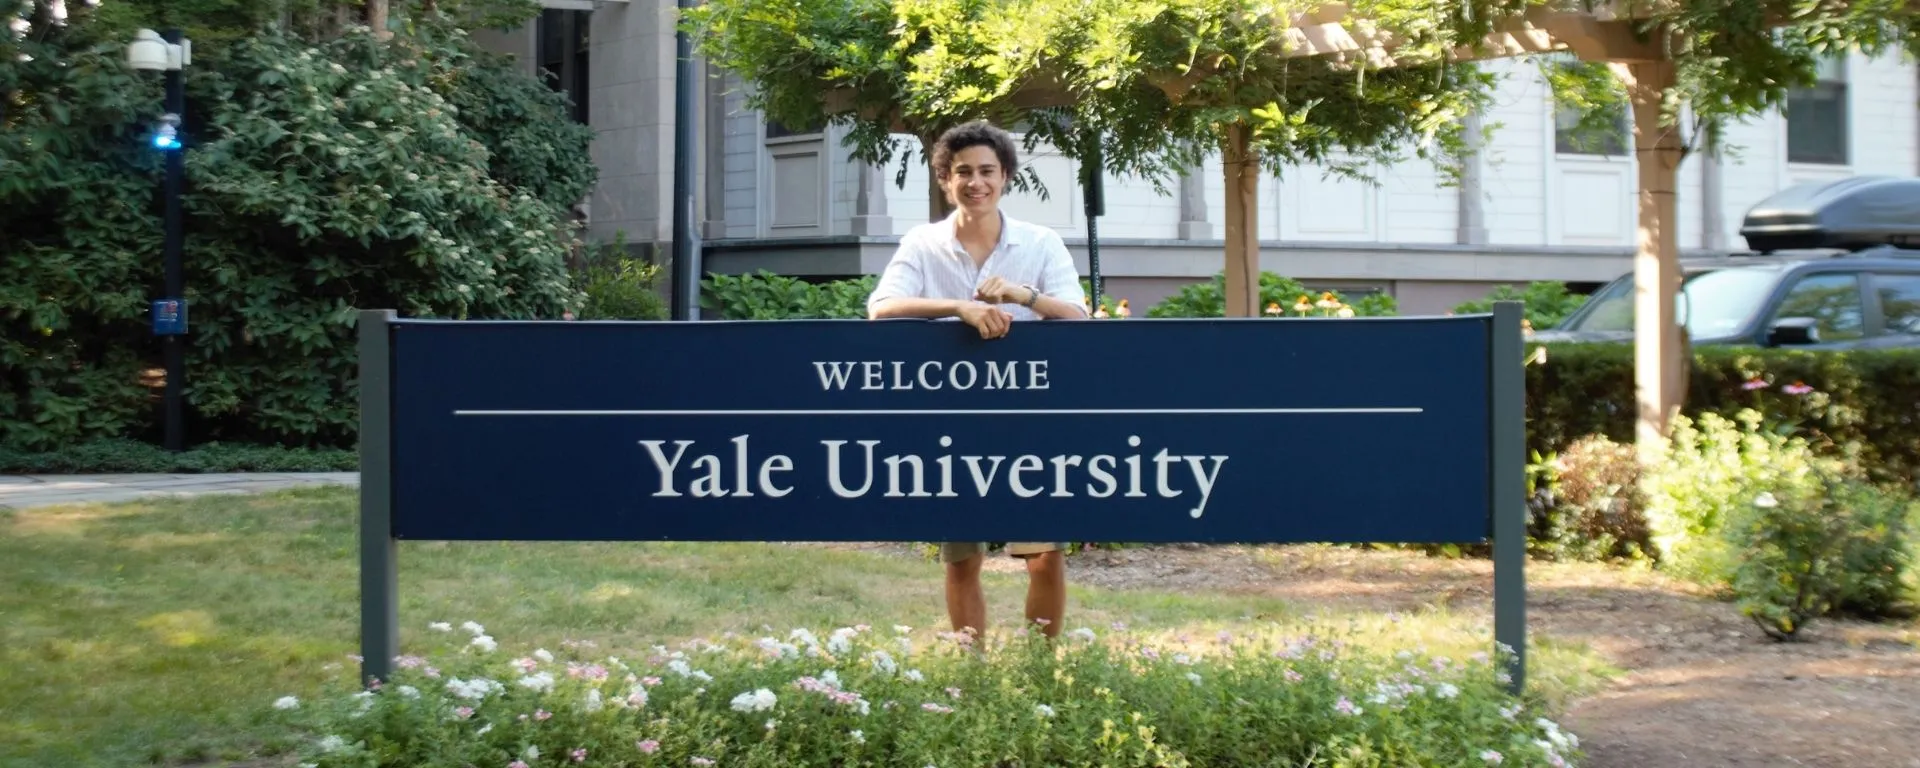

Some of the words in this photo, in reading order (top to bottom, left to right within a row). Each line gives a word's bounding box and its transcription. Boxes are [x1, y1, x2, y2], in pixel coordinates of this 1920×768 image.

[813, 360, 1050, 391] WELCOME
[639, 434, 795, 498] Yale
[821, 435, 1229, 519] University
